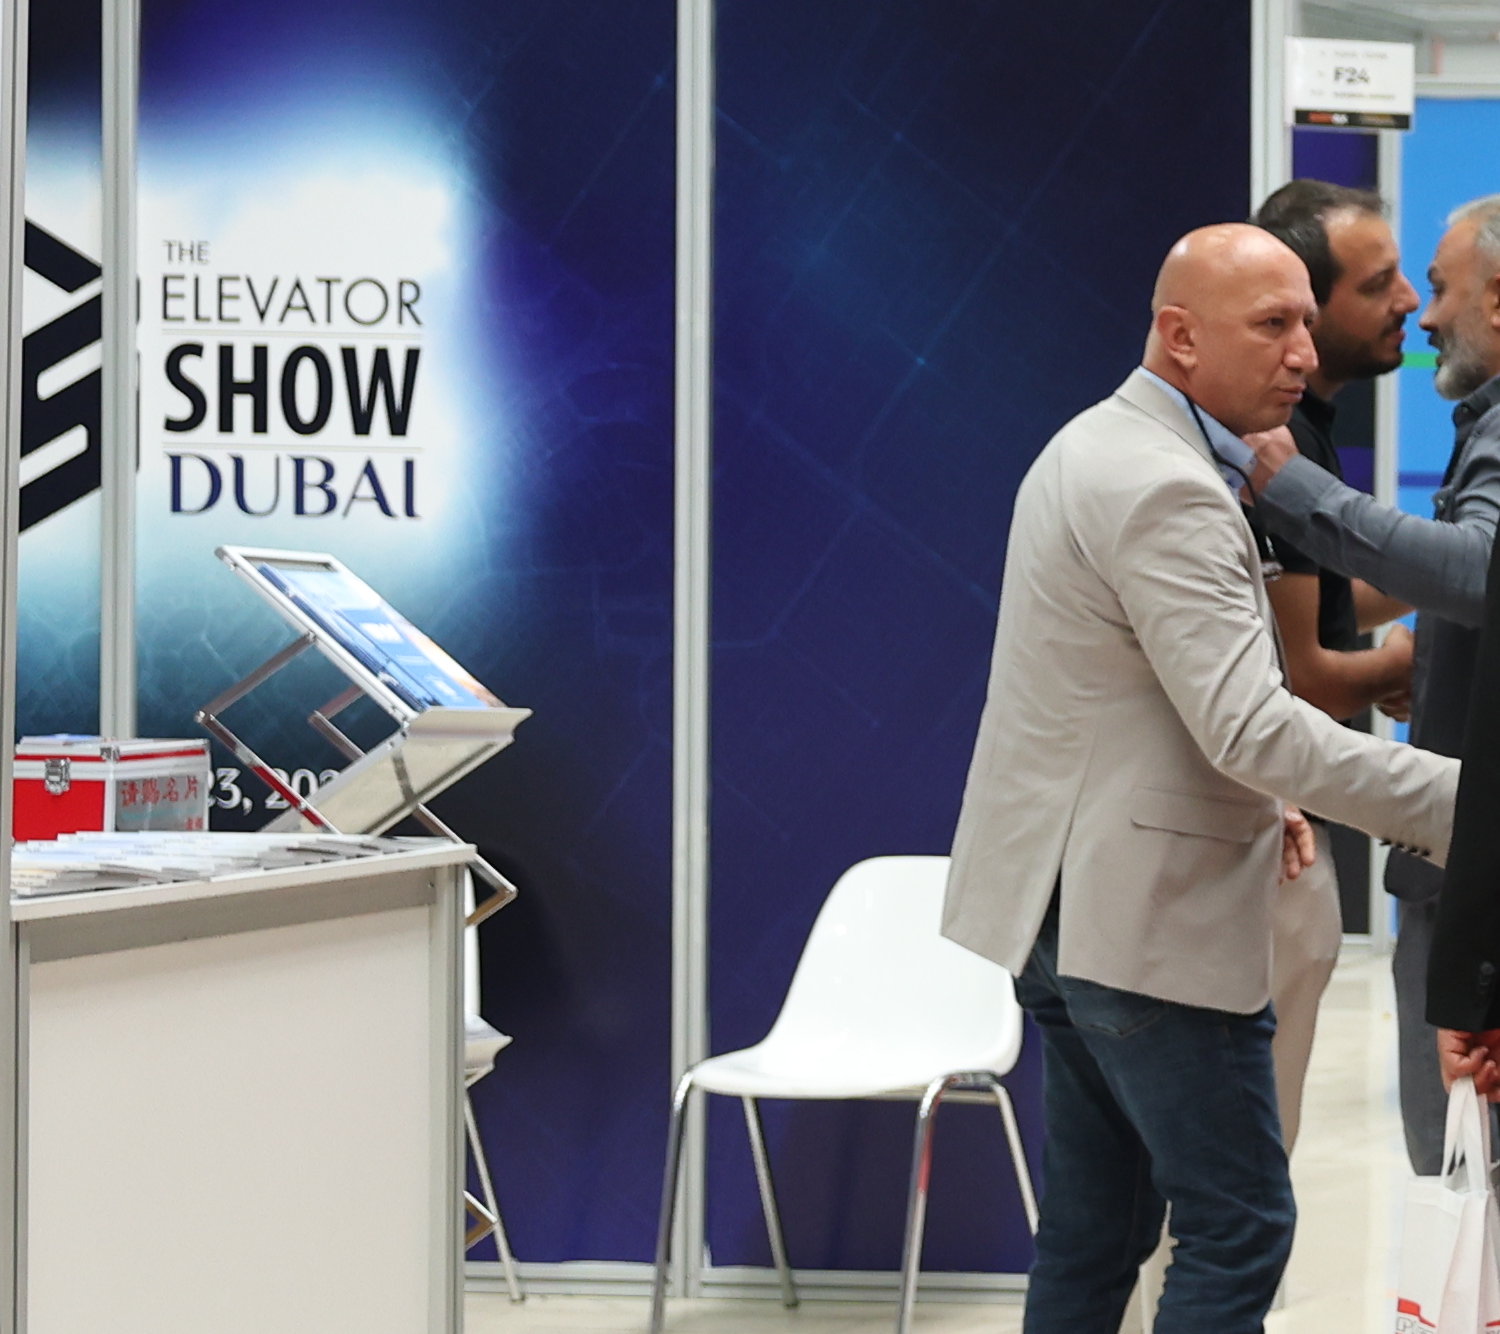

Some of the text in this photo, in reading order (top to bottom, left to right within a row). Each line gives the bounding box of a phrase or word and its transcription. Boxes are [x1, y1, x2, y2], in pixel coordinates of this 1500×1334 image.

[162, 240, 210, 263] THE
[162, 275, 423, 325] ELEVATOR
[164, 343, 421, 436] SHOW
[163, 453, 421, 519] DUBAI
